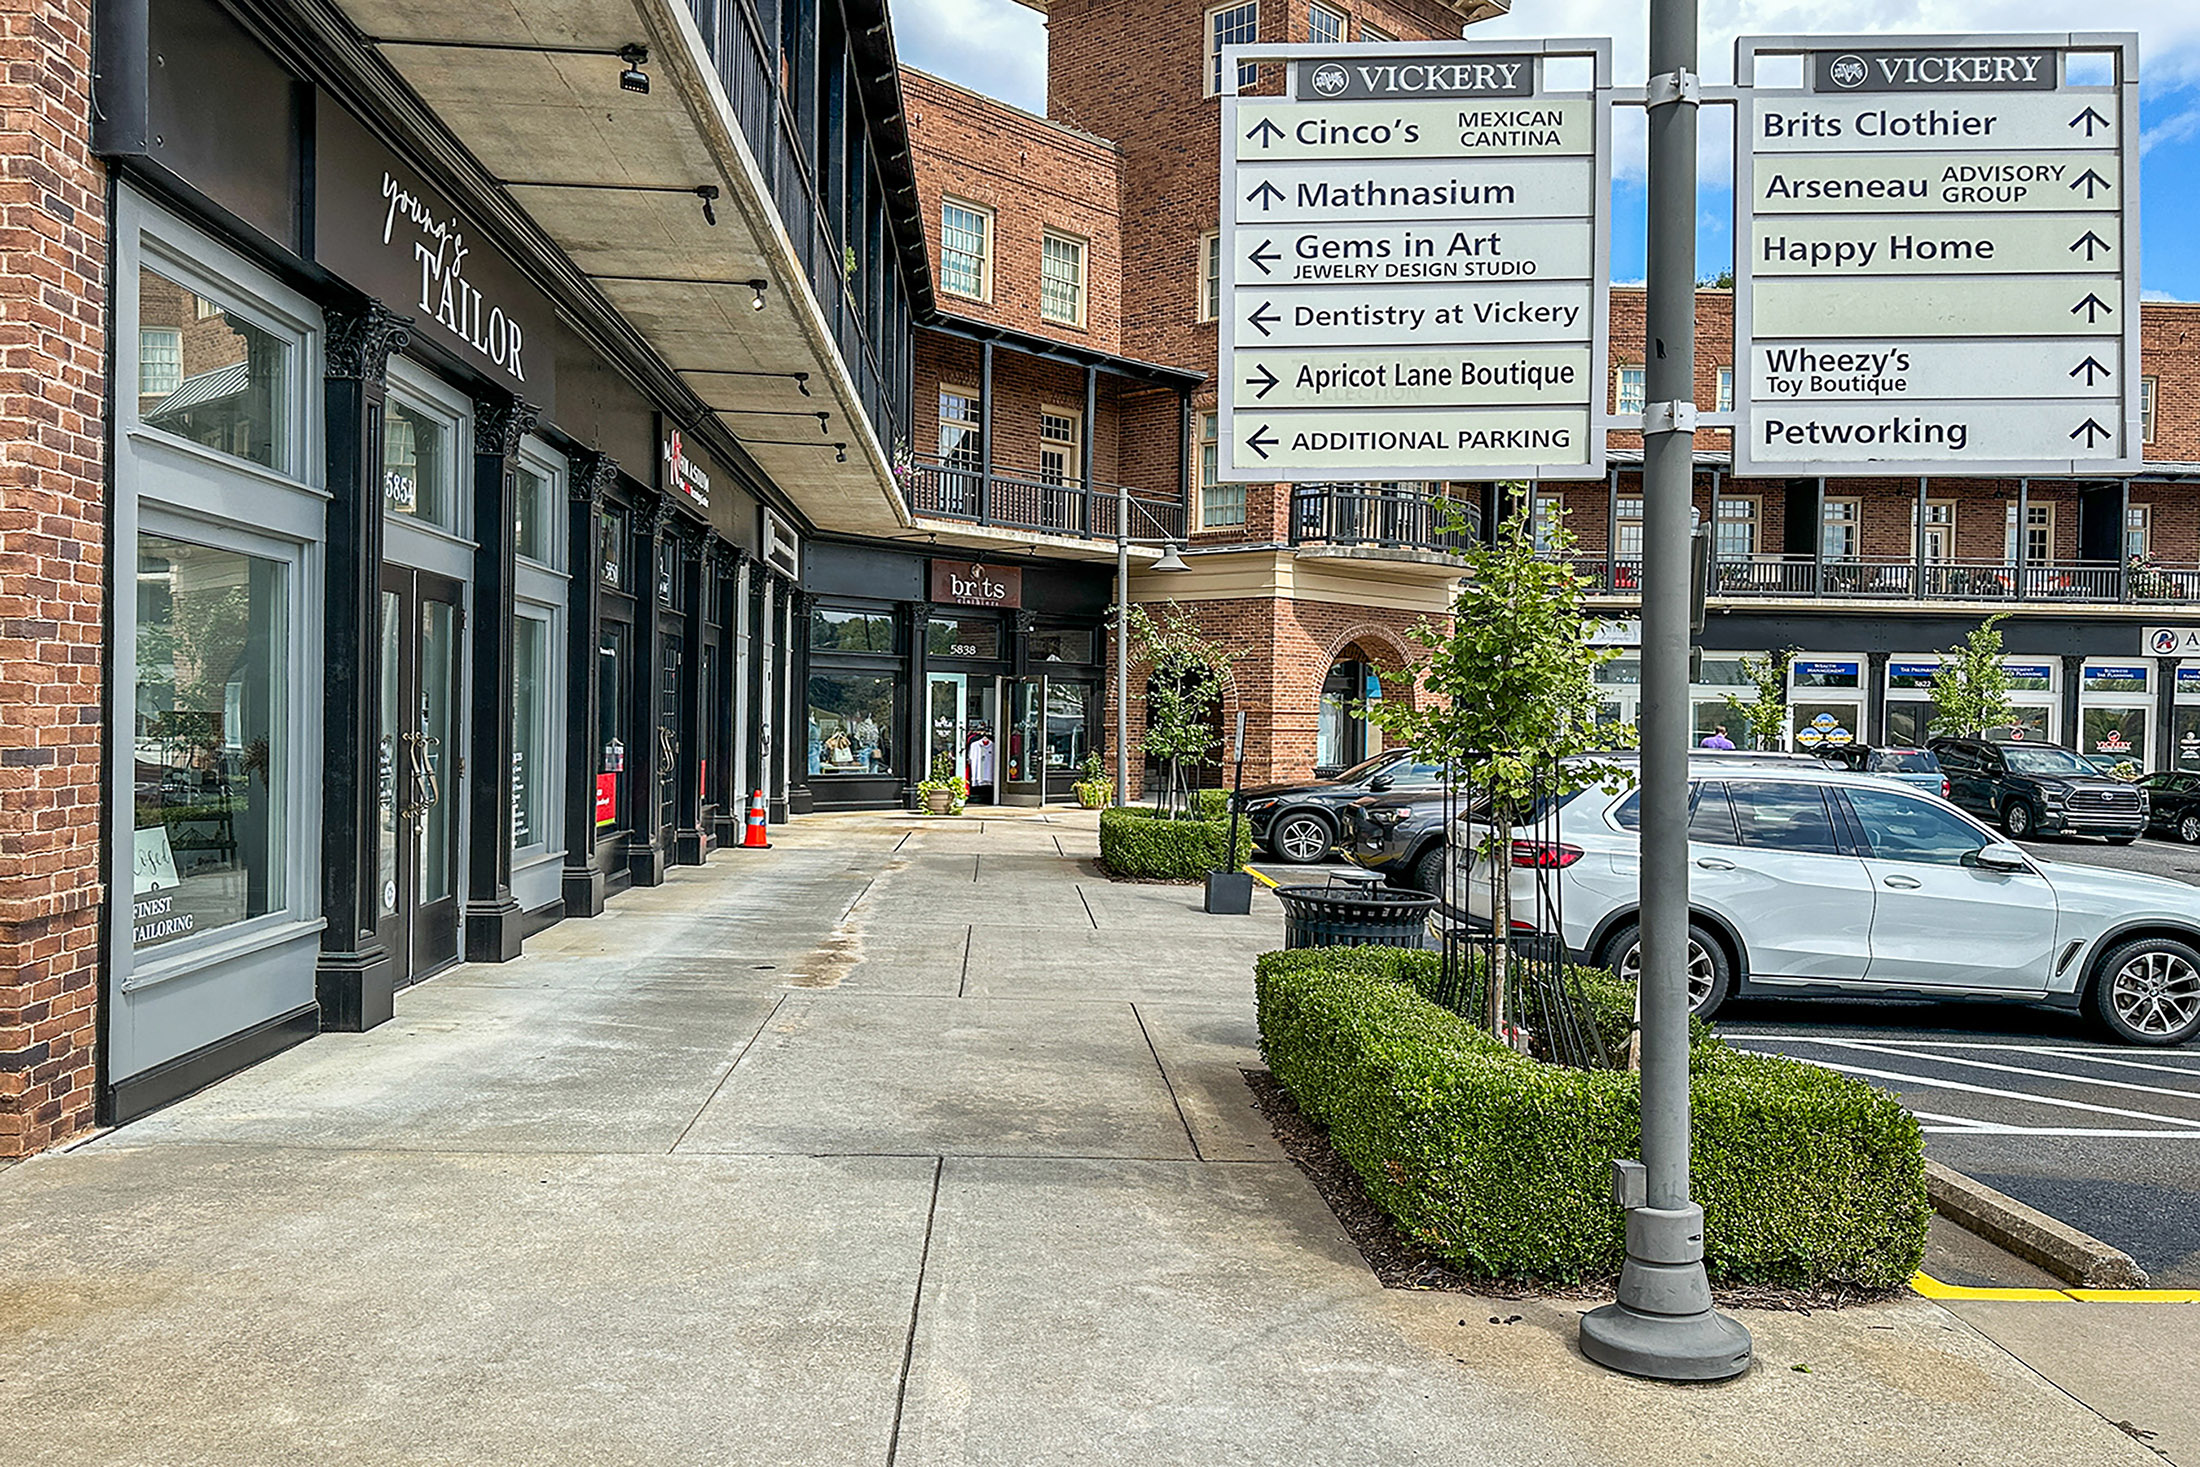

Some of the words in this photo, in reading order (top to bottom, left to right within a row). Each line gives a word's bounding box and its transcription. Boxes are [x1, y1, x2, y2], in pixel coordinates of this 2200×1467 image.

[1356, 63, 1521, 92] VICKERY
[1875, 56, 2042, 84] VICKERY
[1296, 119, 1419, 145] Cinco’s
[1458, 110, 1563, 128] MEXICAN
[1764, 112, 1842, 137] Brits
[1855, 109, 1997, 137] Clothier
[1460, 130, 1561, 147] CANTINA
[1765, 175, 1928, 199] Arseneau
[1941, 164, 2066, 183] ADVISORY
[1297, 179, 1514, 207] Mathnasium
[1942, 186, 2027, 203] GROUP
[1295, 234, 1391, 259] Gems
[1405, 232, 1433, 257] in
[1446, 232, 1501, 257] Art
[1764, 236, 1877, 267] Happy
[1890, 235, 1994, 260] Home
[1293, 263, 1379, 280] JEWELRY
[1385, 262, 1457, 278] DESIGN
[1464, 260, 1536, 277] STUDIO
[414, 241, 526, 383] TAILOR
[1294, 304, 1425, 331] Dentistry
[1435, 304, 1464, 325] at
[1473, 301, 1580, 328] Vickery
[1765, 347, 1910, 376] Wheezy’s
[1295, 362, 1387, 394] Apricot
[1395, 363, 1452, 387] Lane
[1461, 359, 1575, 391] Boutique
[1766, 377, 1803, 397] Toy
[1810, 374, 1907, 394] Boutique
[1291, 431, 1449, 451] ADDITIONAL
[1458, 429, 1570, 449] PARKING
[1765, 417, 1967, 450] Petworking
[950, 644, 977, 656] 5838
